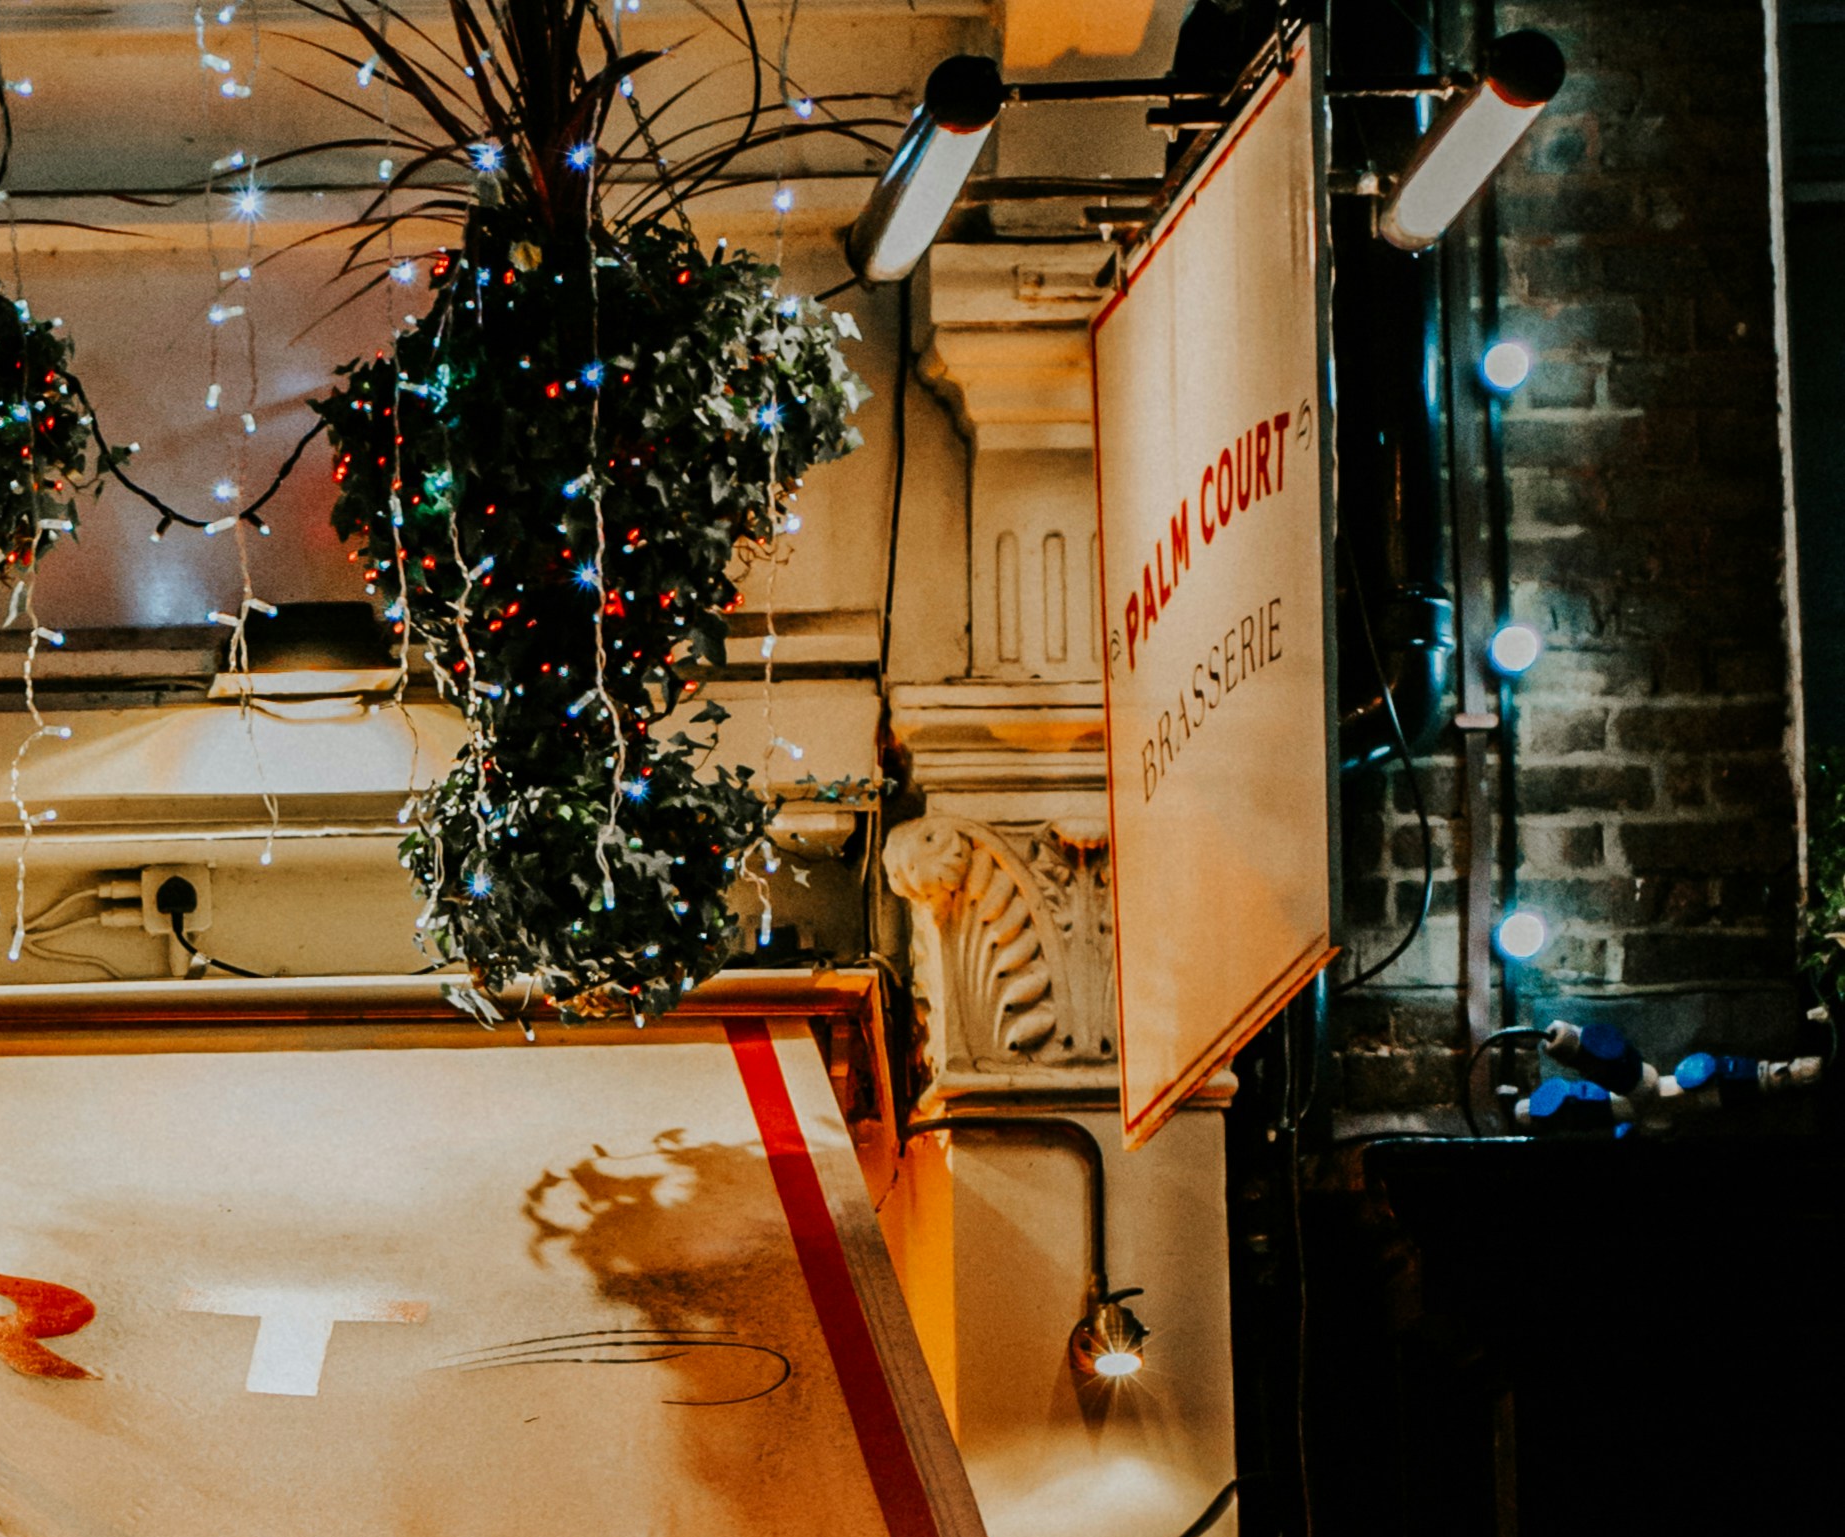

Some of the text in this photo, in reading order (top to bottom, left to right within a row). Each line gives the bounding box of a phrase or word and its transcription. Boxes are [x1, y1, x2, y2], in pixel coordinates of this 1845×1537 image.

[1124, 410, 1291, 673] PALM COURT
[1140, 596, 1284, 804] BRASSERIE
